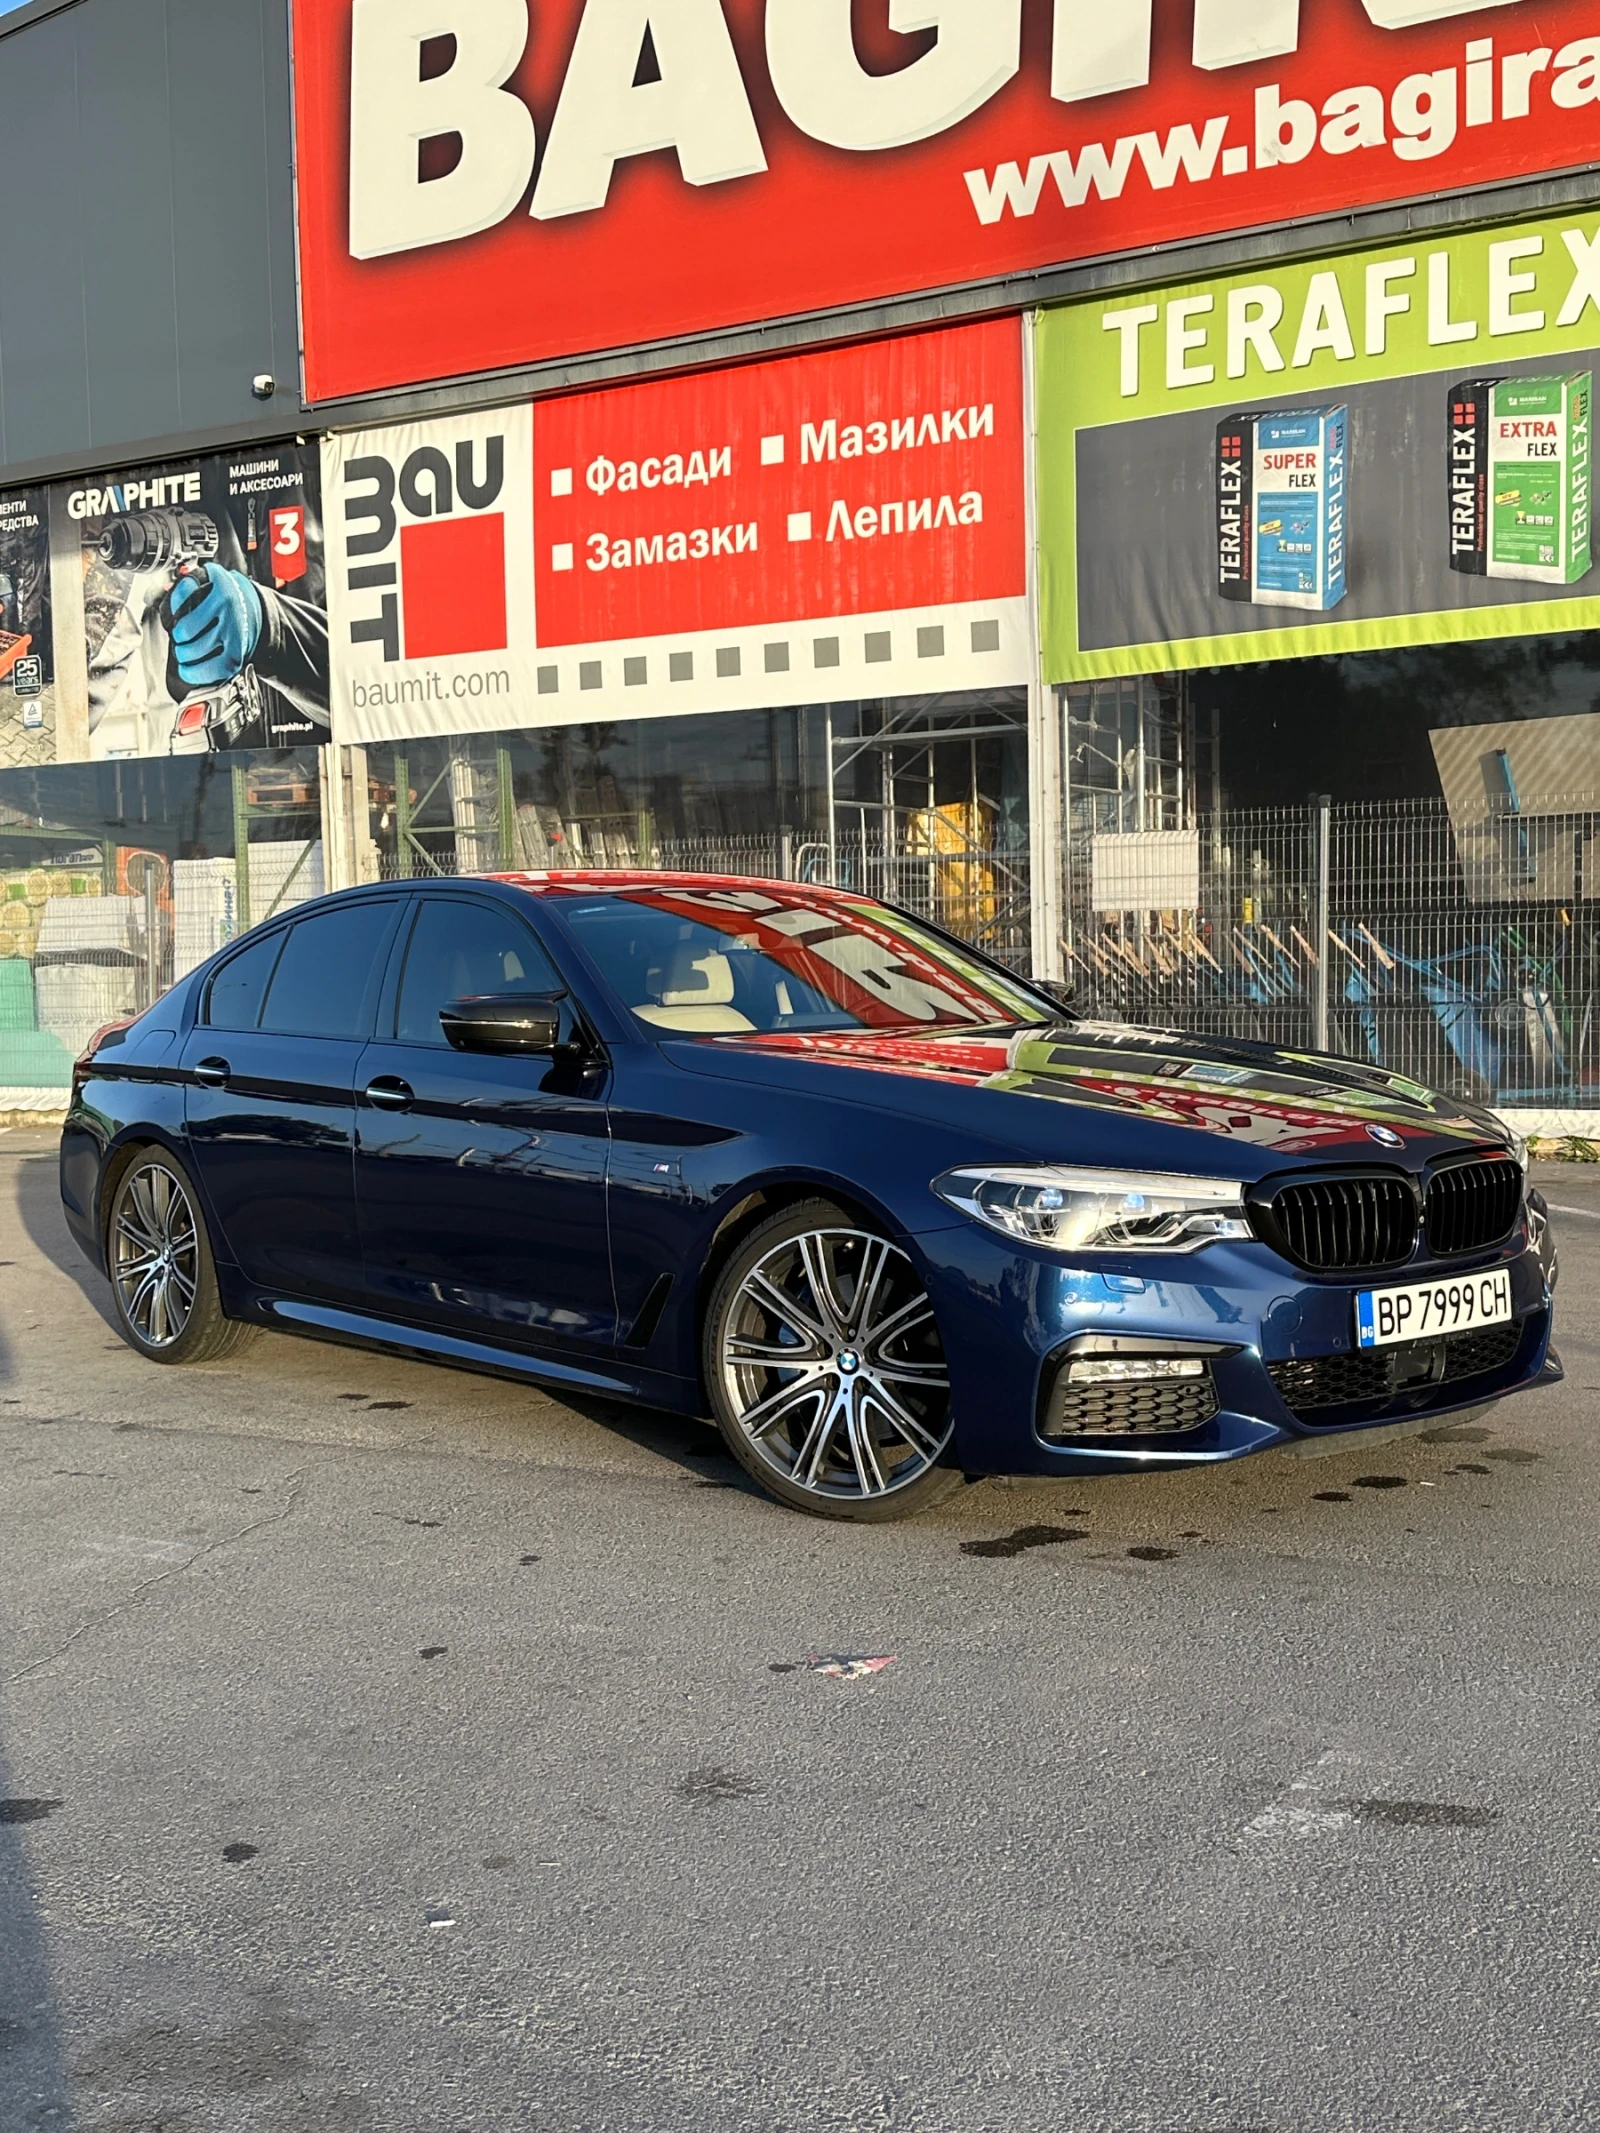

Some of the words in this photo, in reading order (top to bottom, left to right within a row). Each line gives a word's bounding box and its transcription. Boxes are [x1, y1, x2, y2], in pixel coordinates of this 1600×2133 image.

[963, 36, 1600, 225] www.bagira
[1102, 226, 1600, 397] TERAFLEX
[801, 404, 995, 464] Мазилки
[1500, 421, 1557, 438] EXTRA
[1527, 443, 1557, 456] FLEX
[229, 459, 279, 478] МАШИНИ
[585, 445, 732, 497] Фасади
[1263, 453, 1316, 470] SUPER
[1288, 474, 1316, 487] FLEX
[68, 472, 200, 520] GRAPHITE
[229, 483, 238, 496] И
[240, 473, 304, 494] АКСЕСОАРИ
[1452, 427, 1475, 555] TERAFLEX
[1572, 416, 1588, 563] TERAFLEX
[0, 500, 26, 515] ЕНТИ
[826, 491, 983, 543] Лепила
[1220, 460, 1241, 584] TERAFLEX
[1328, 449, 1343, 590] TERAFLEX
[274, 511, 300, 555] 3
[586, 521, 758, 571] Замазки
[16, 659, 38, 677] 25
[17, 676, 38, 686] years
[352, 669, 510, 708] baumit.com
[271, 722, 313, 733] graphite.pl
[1378, 1293, 1412, 1337] BP
[1418, 1283, 1475, 1330] 7999
[1480, 1276, 1507, 1317] CH
[1361, 1326, 1373, 1338] BG
